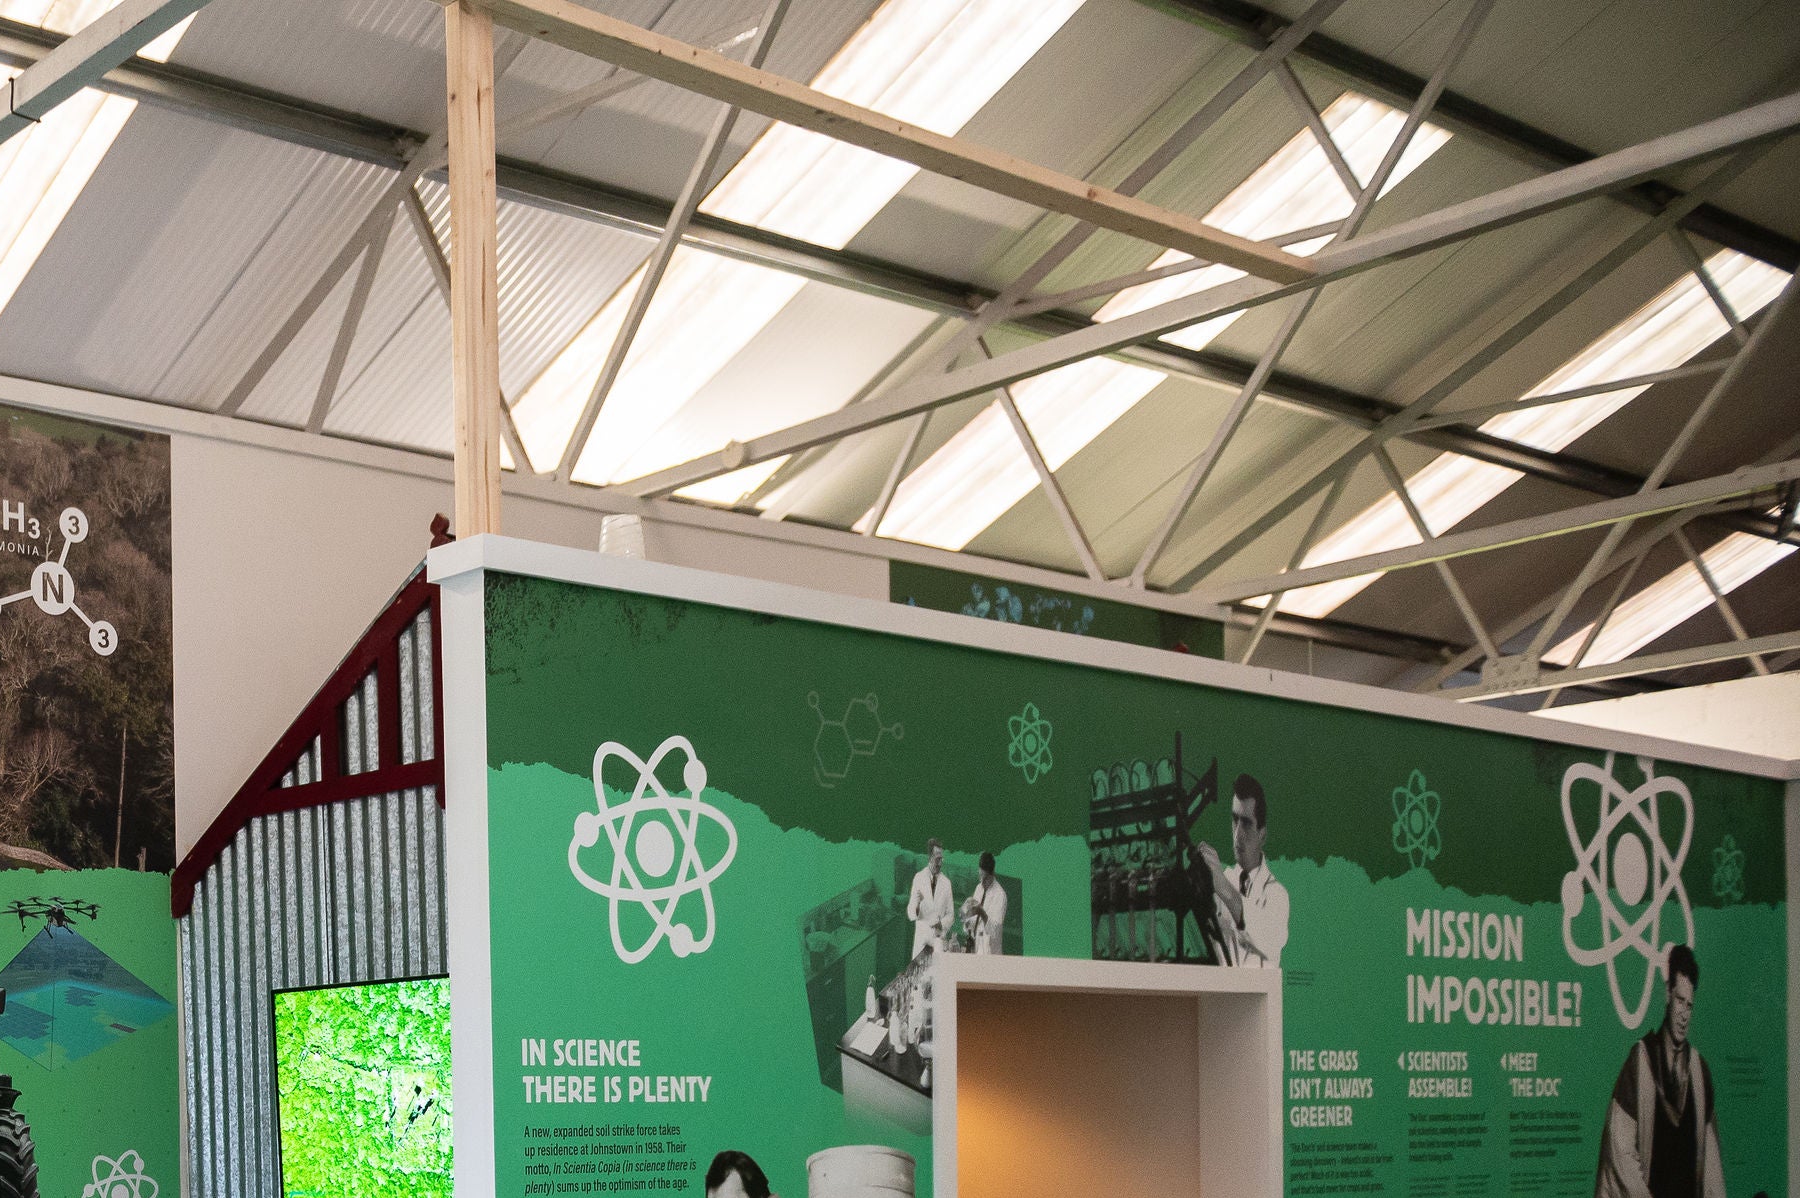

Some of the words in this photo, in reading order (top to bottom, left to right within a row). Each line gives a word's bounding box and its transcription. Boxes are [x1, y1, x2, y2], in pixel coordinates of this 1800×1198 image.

[67, 515, 80, 536] 3
[42, 572, 64, 604] N
[97, 628, 110, 649] 3
[1405, 907, 1523, 962] MISSION
[521, 1038, 546, 1066] IN
[554, 1039, 641, 1067] SCIENCE
[1289, 1050, 1315, 1071] THE
[1318, 1050, 1358, 1072] GRASS
[1408, 1051, 1468, 1072] SCIENTISTS
[1508, 1052, 1538, 1072] MEET
[522, 1076, 596, 1104] THERE
[604, 1076, 622, 1102] IS
[629, 1076, 712, 1102] PLENTY
[1324, 1077, 1374, 1100] ALWAYS
[1408, 1077, 1472, 1098] ASSEMBLE!
[1289, 1106, 1353, 1128] GREENER
[532, 1128, 551, 1138] new,
[553, 1124, 593, 1139] expanded
[596, 1124, 609, 1136] soil
[612, 1124, 634, 1136] strike
[636, 1124, 656, 1135] force
[659, 1123, 680, 1135] takes
[524, 1147, 534, 1158] up
[537, 1143, 578, 1156] residence
[580, 1144, 588, 1154] at
[590, 1142, 633, 1154] Johnstown
[635, 1141, 642, 1153] in
[645, 1142, 664, 1153] 1958.
[666, 1141, 686, 1152] Their
[525, 1163, 551, 1176] motto,
[553, 1162, 561, 1174] In
[563, 1161, 595, 1174] Scientia
[598, 1160, 620, 1174] Copia
[635, 1159, 665, 1171] science
[667, 1159, 687, 1170] there
[689, 1158, 696, 1169] is
[525, 1180, 554, 1195] plenty)
[557, 1182, 578, 1192] sums
[581, 1182, 591, 1194] up
[593, 1179, 606, 1191] the
[608, 1179, 645, 1193] optimism
[648, 1177, 655, 1189] of
[657, 1177, 670, 1188] the
[672, 1179, 689, 1191] age.
